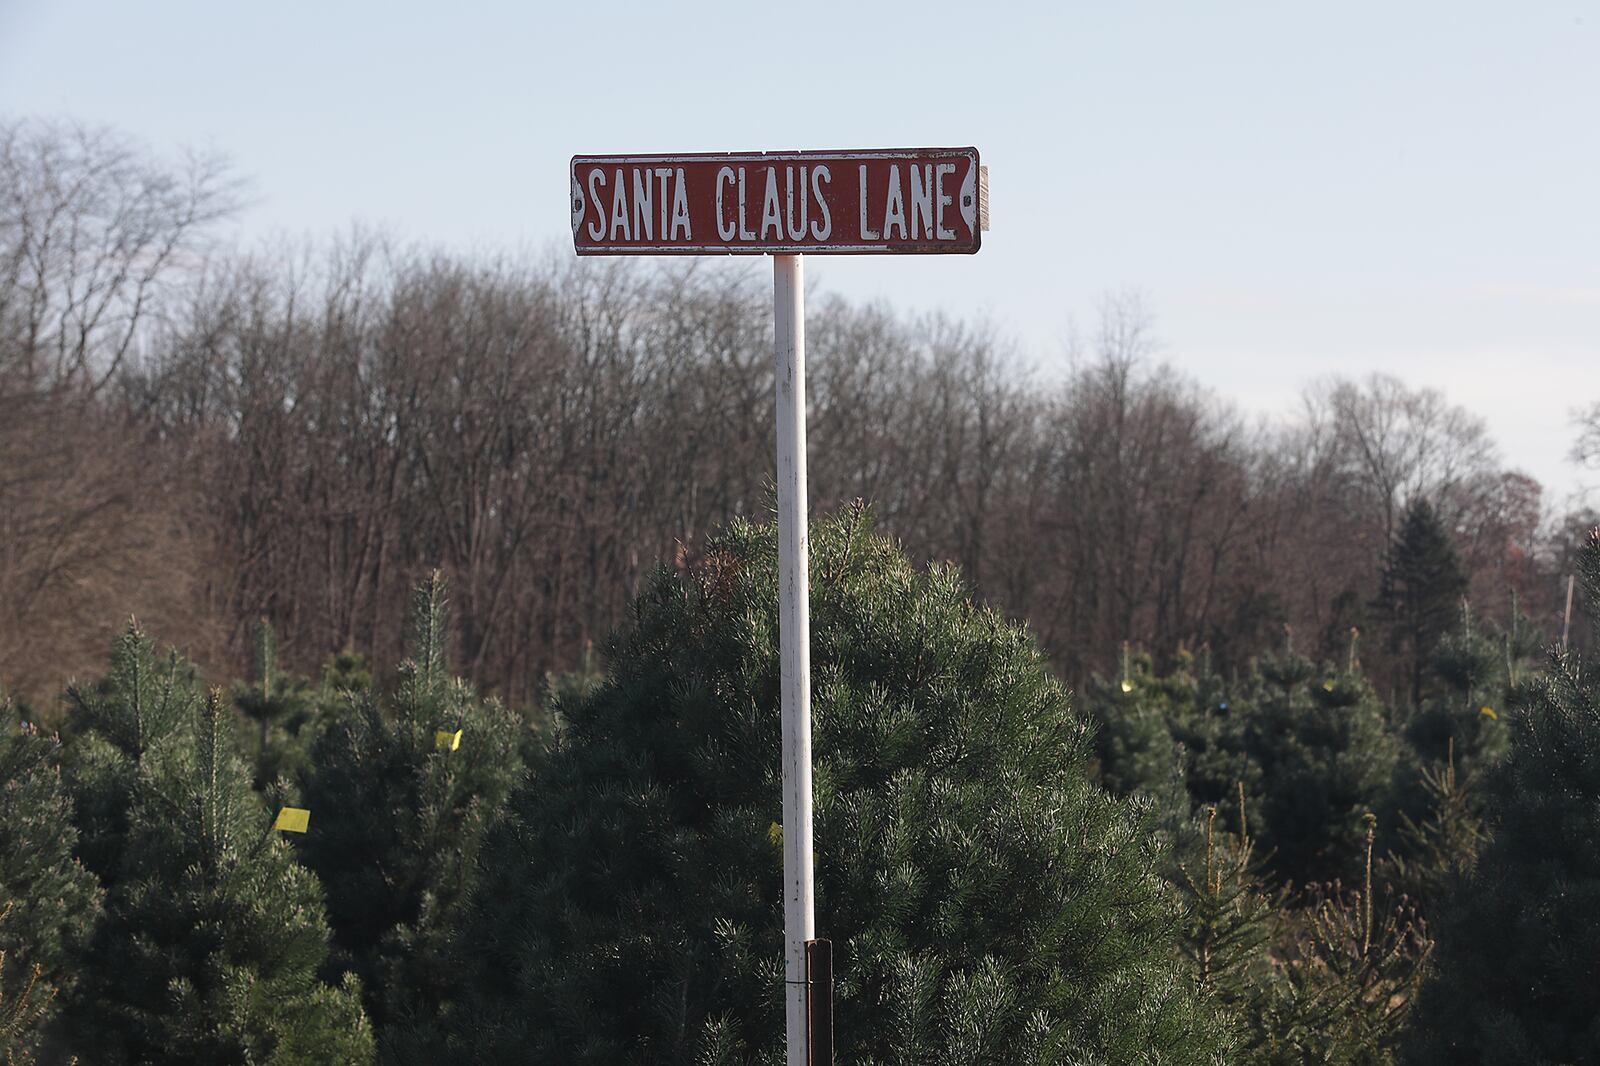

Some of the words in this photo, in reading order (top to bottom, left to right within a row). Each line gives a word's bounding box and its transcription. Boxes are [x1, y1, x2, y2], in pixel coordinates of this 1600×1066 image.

[588, 168, 692, 242] SANTA
[716, 165, 832, 242] CLAUS
[859, 163, 957, 241] LANE
